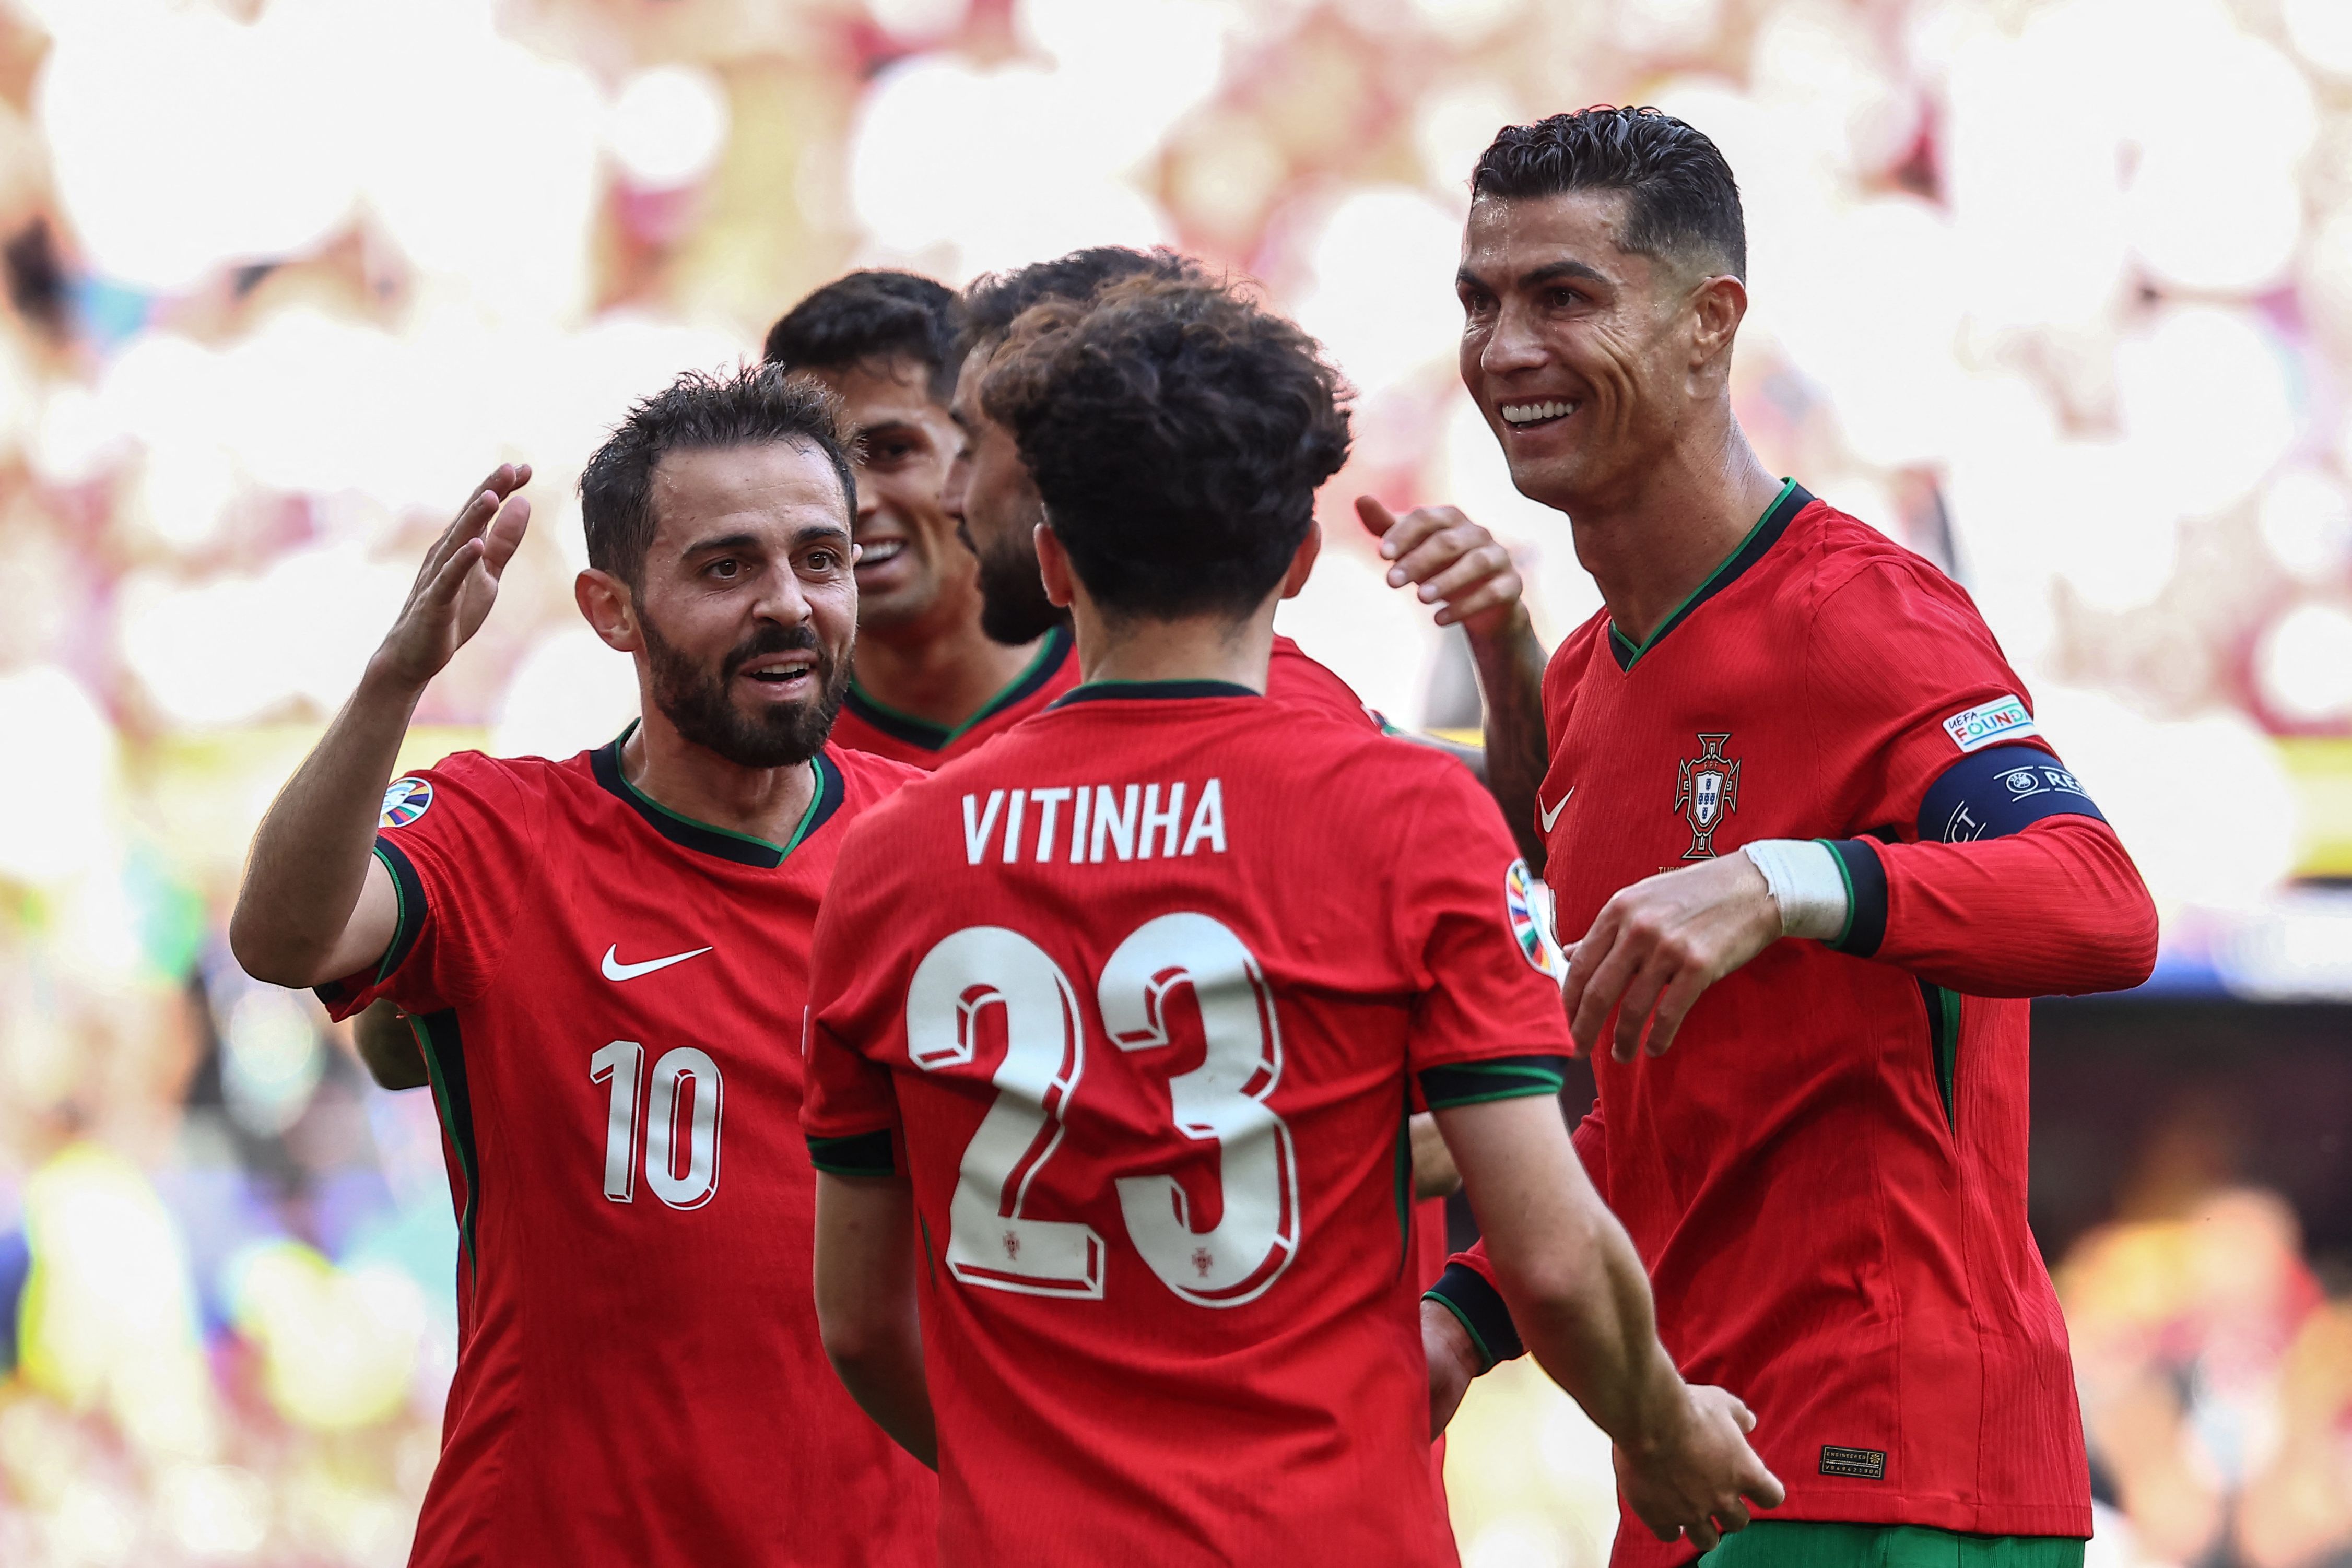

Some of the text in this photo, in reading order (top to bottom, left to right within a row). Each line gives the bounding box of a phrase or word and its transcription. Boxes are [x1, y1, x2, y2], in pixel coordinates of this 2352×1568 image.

[1948, 711, 1978, 729] UEFA
[1954, 709, 2028, 741] FOUND
[961, 778, 1228, 865] VITINHA
[590, 1040, 724, 1211] 10
[905, 912, 1301, 1308] 23
[1826, 1452, 1866, 1460] ENGINEERED
